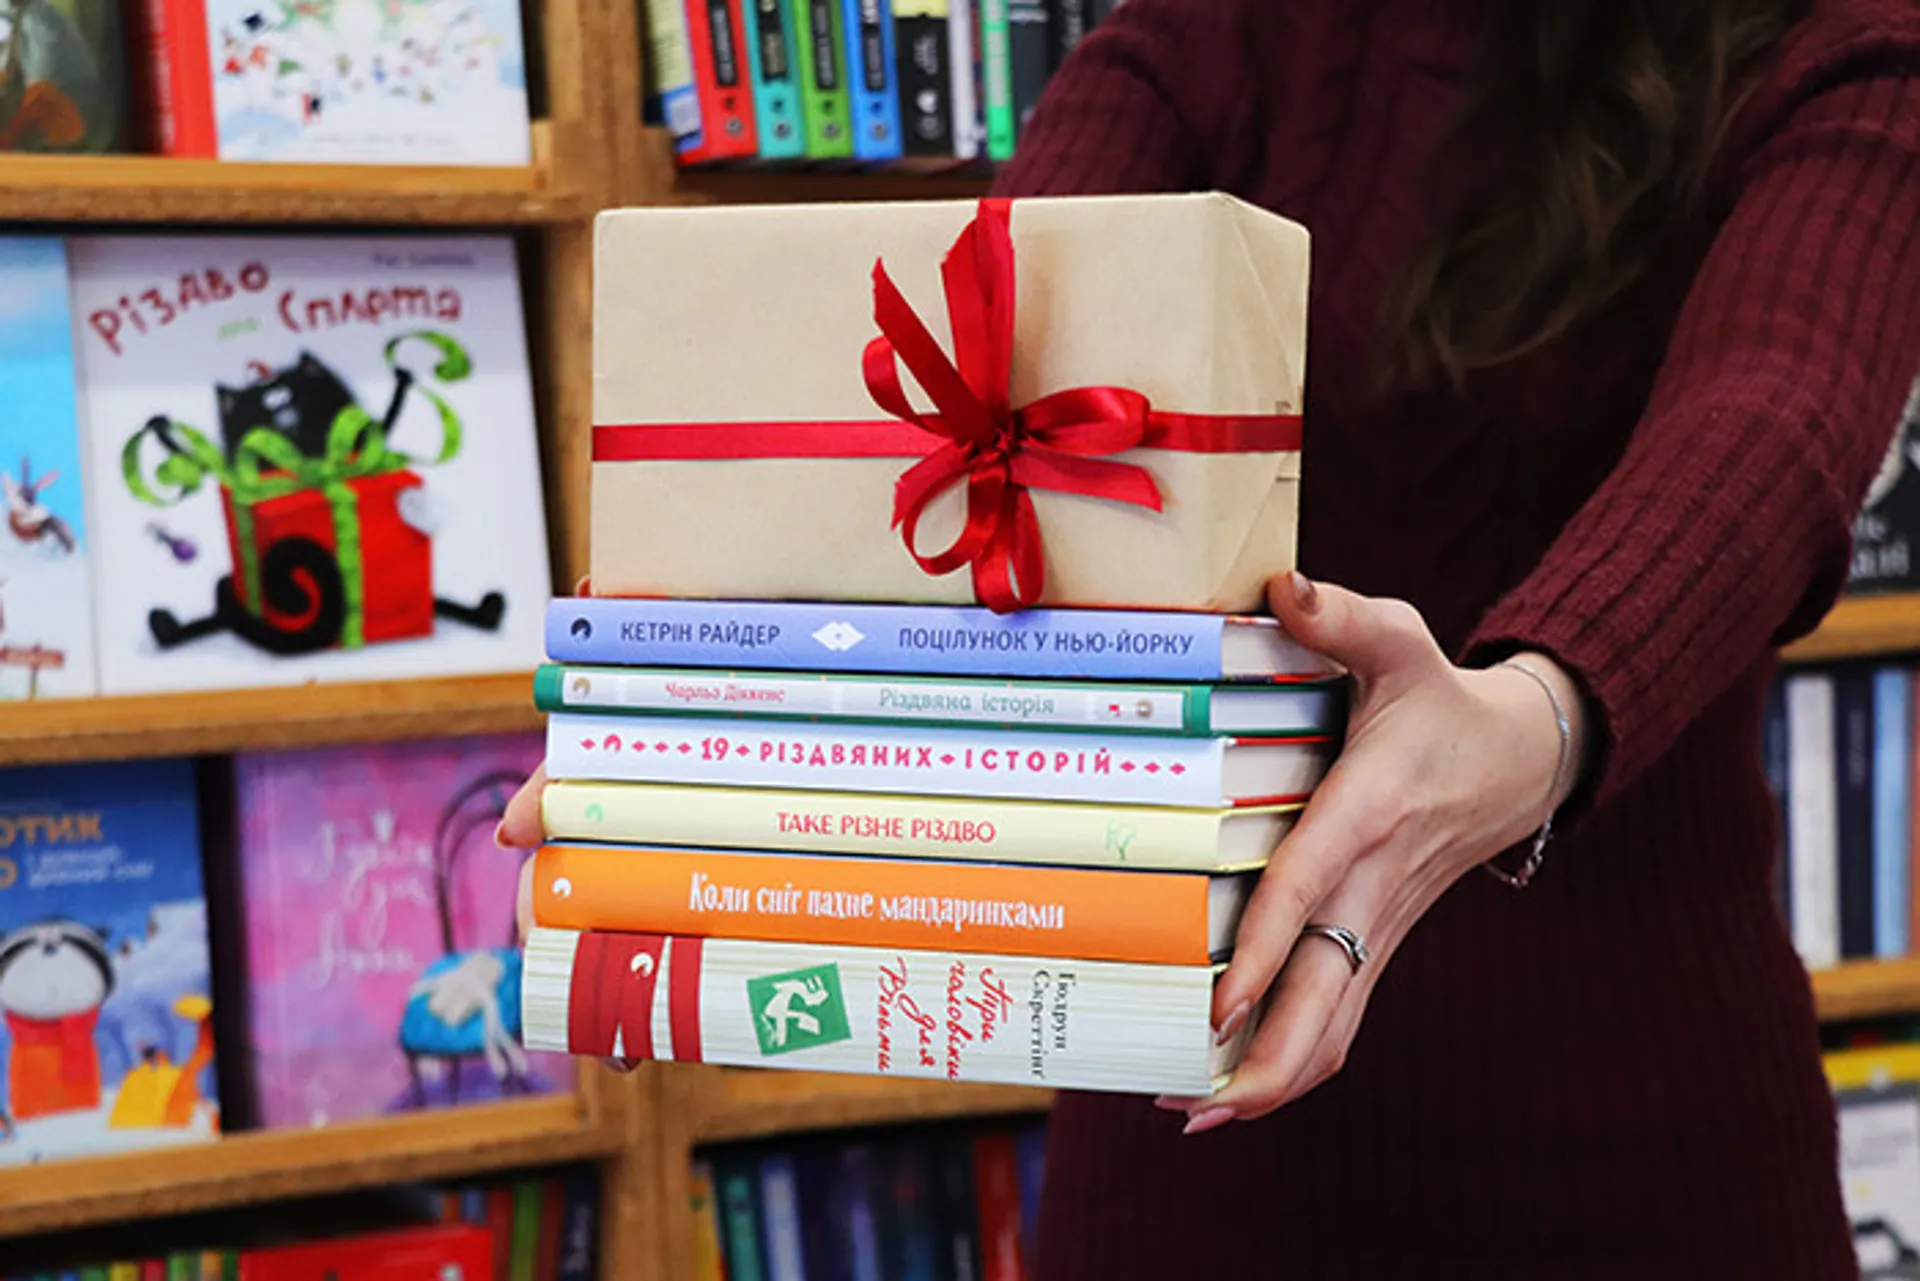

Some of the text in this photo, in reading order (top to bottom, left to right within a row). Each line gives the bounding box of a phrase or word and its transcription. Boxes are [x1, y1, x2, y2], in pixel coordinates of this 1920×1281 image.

[620, 622, 781, 648] КЕТРІН РАЙДЕР
[899, 627, 1194, 654] ПОЦІЛУНОК У НЬЮ-ЙОРКУ
[879, 688, 1055, 716] Різдвяна історія
[701, 738, 1111, 776] 19 РІЗДВЯНИХ ІСТОРІЙ
[777, 813, 996, 843] ТАКЕ РІЗНЕ РІЗДВО
[688, 871, 1065, 932] Коли сніг пахне мандаринками
[946, 960, 974, 1080] чоловіки
[965, 967, 1014, 1043] Три
